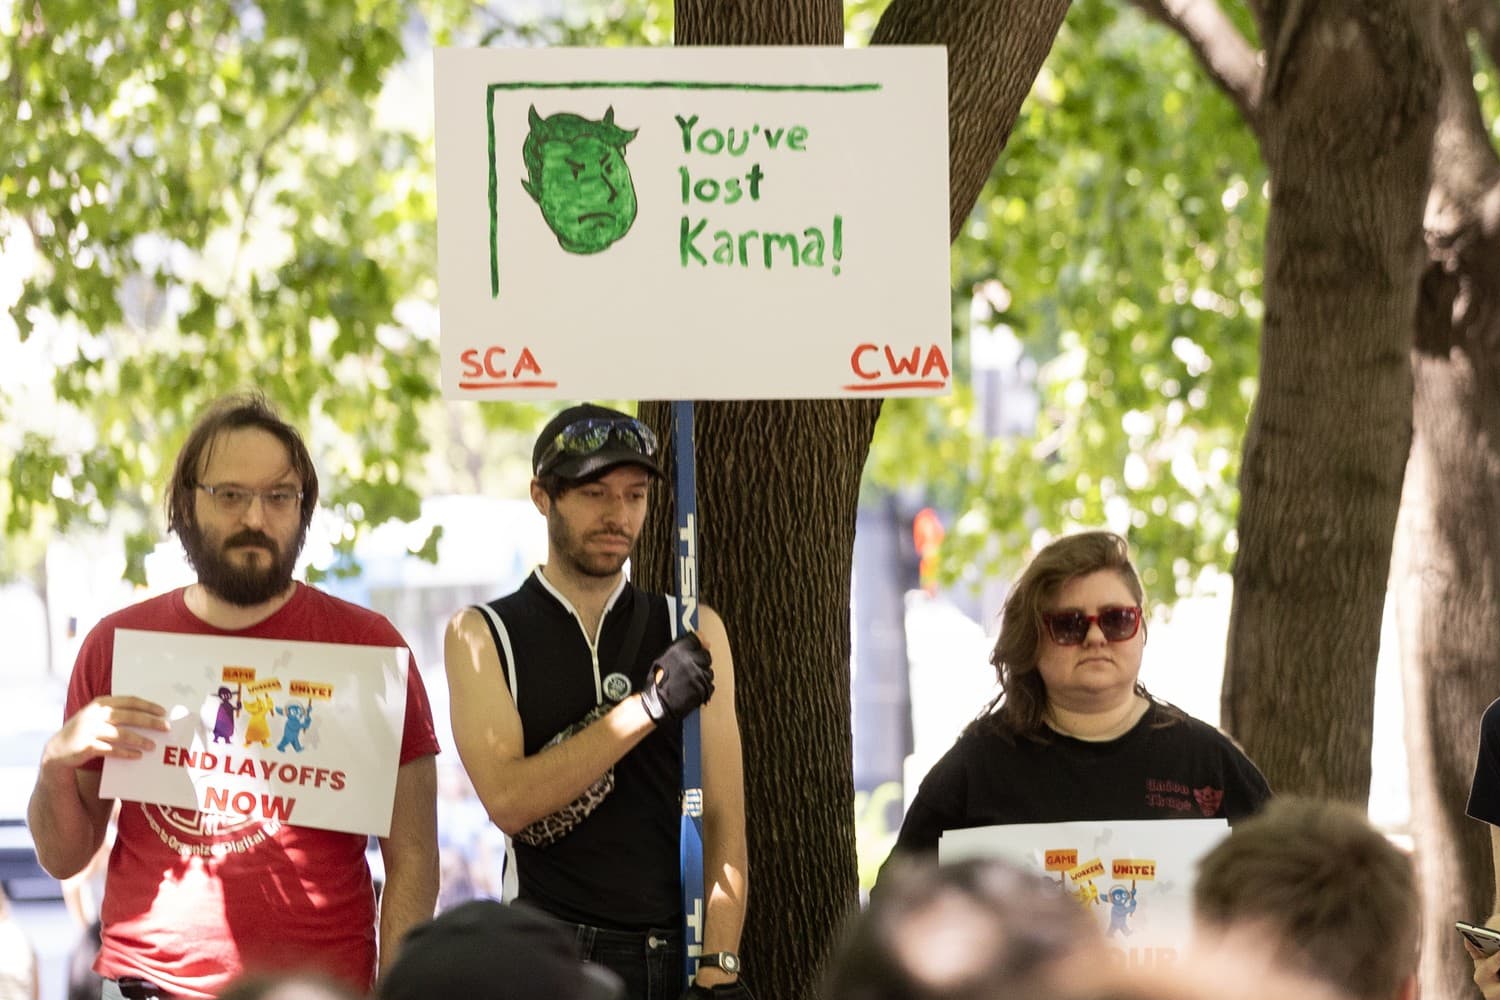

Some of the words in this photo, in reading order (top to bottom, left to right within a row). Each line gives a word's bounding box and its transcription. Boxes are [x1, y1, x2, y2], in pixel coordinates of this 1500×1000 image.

[674, 113, 810, 157] You've
[678, 162, 765, 206] lost
[679, 213, 843, 277] Karma!
[460, 346, 543, 379] SCA
[850, 343, 950, 380] CWA
[290, 682, 332, 697] UNITE!
[163, 745, 218, 770] END
[223, 755, 346, 791] LAYOFFS
[203, 786, 297, 822] NOW
[1046, 854, 1077, 866] GAME
[1070, 861, 1105, 882] WORKERS
[1113, 864, 1156, 876] UNITE!
